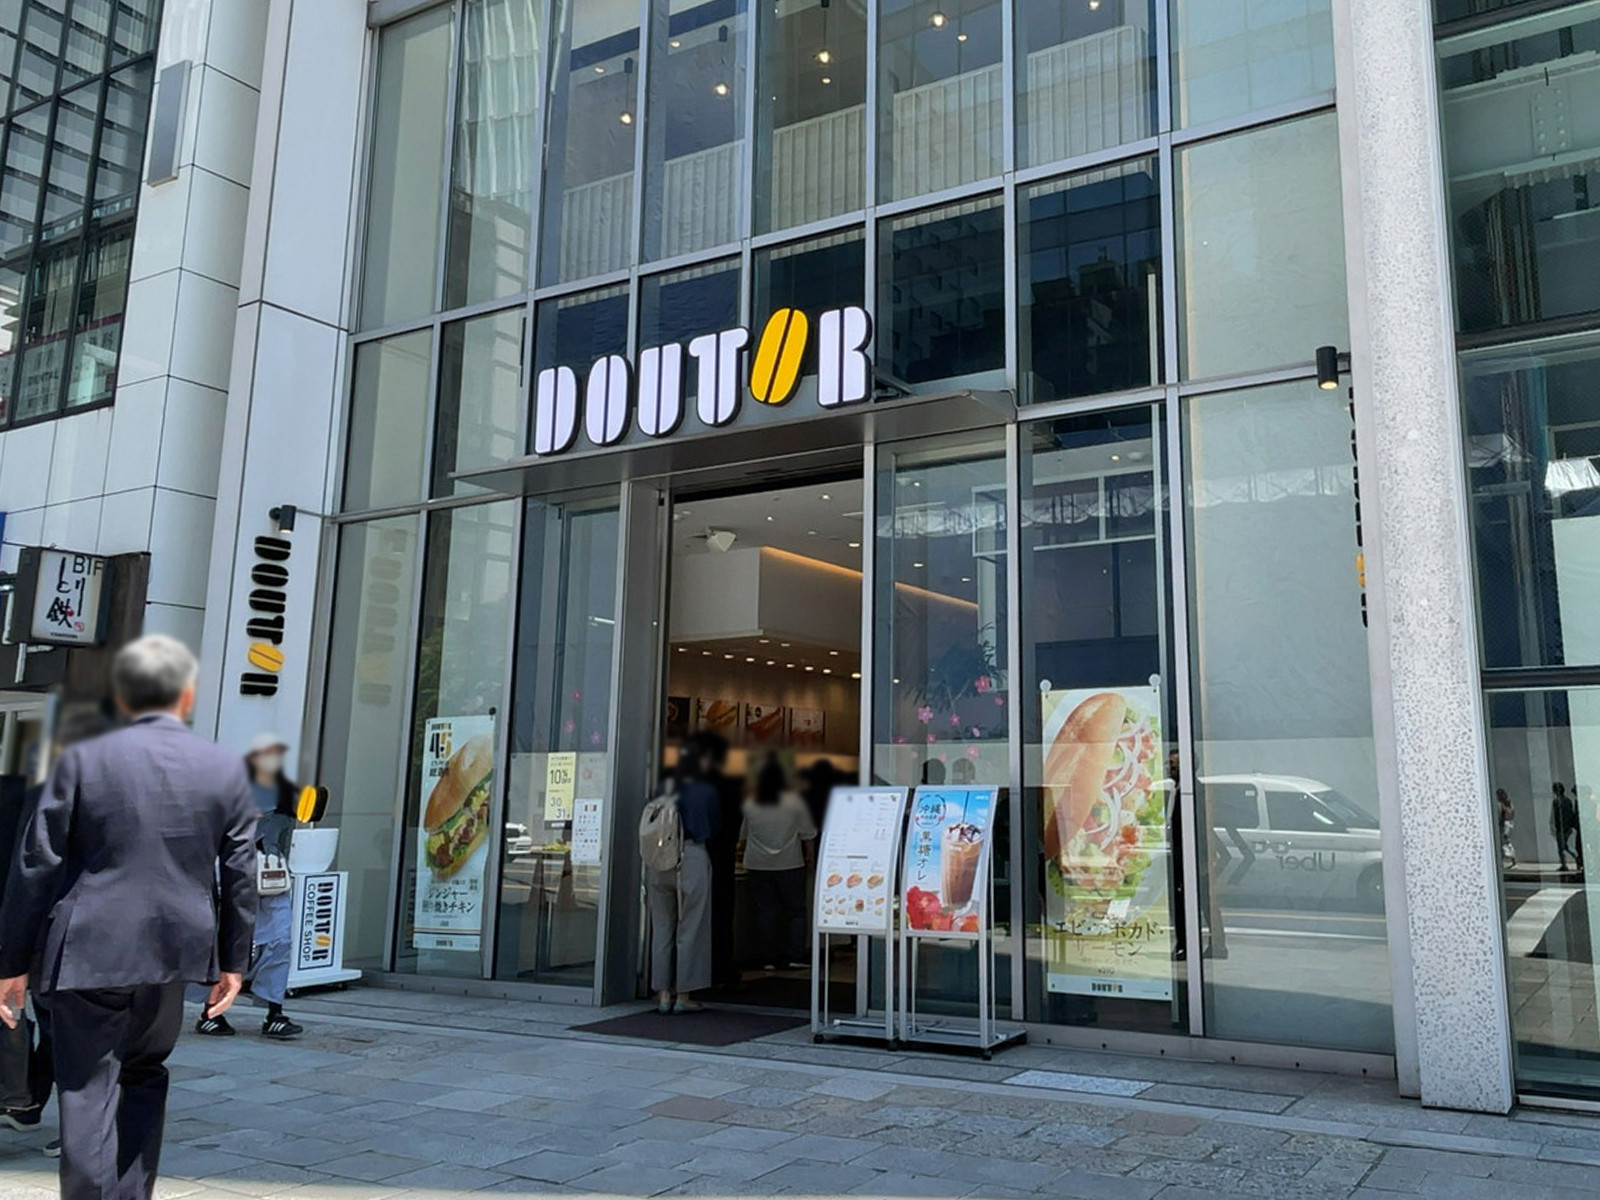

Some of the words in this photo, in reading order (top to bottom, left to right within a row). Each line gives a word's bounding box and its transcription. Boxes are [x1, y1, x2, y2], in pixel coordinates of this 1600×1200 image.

[534, 306, 872, 456] DOUTOR
[73, 555, 104, 576] B1F
[240, 535, 292, 697] DOUTOR
[304, 883, 316, 927] COFFEE
[312, 882, 334, 961] DOUTOR
[302, 930, 313, 962] SHOP
